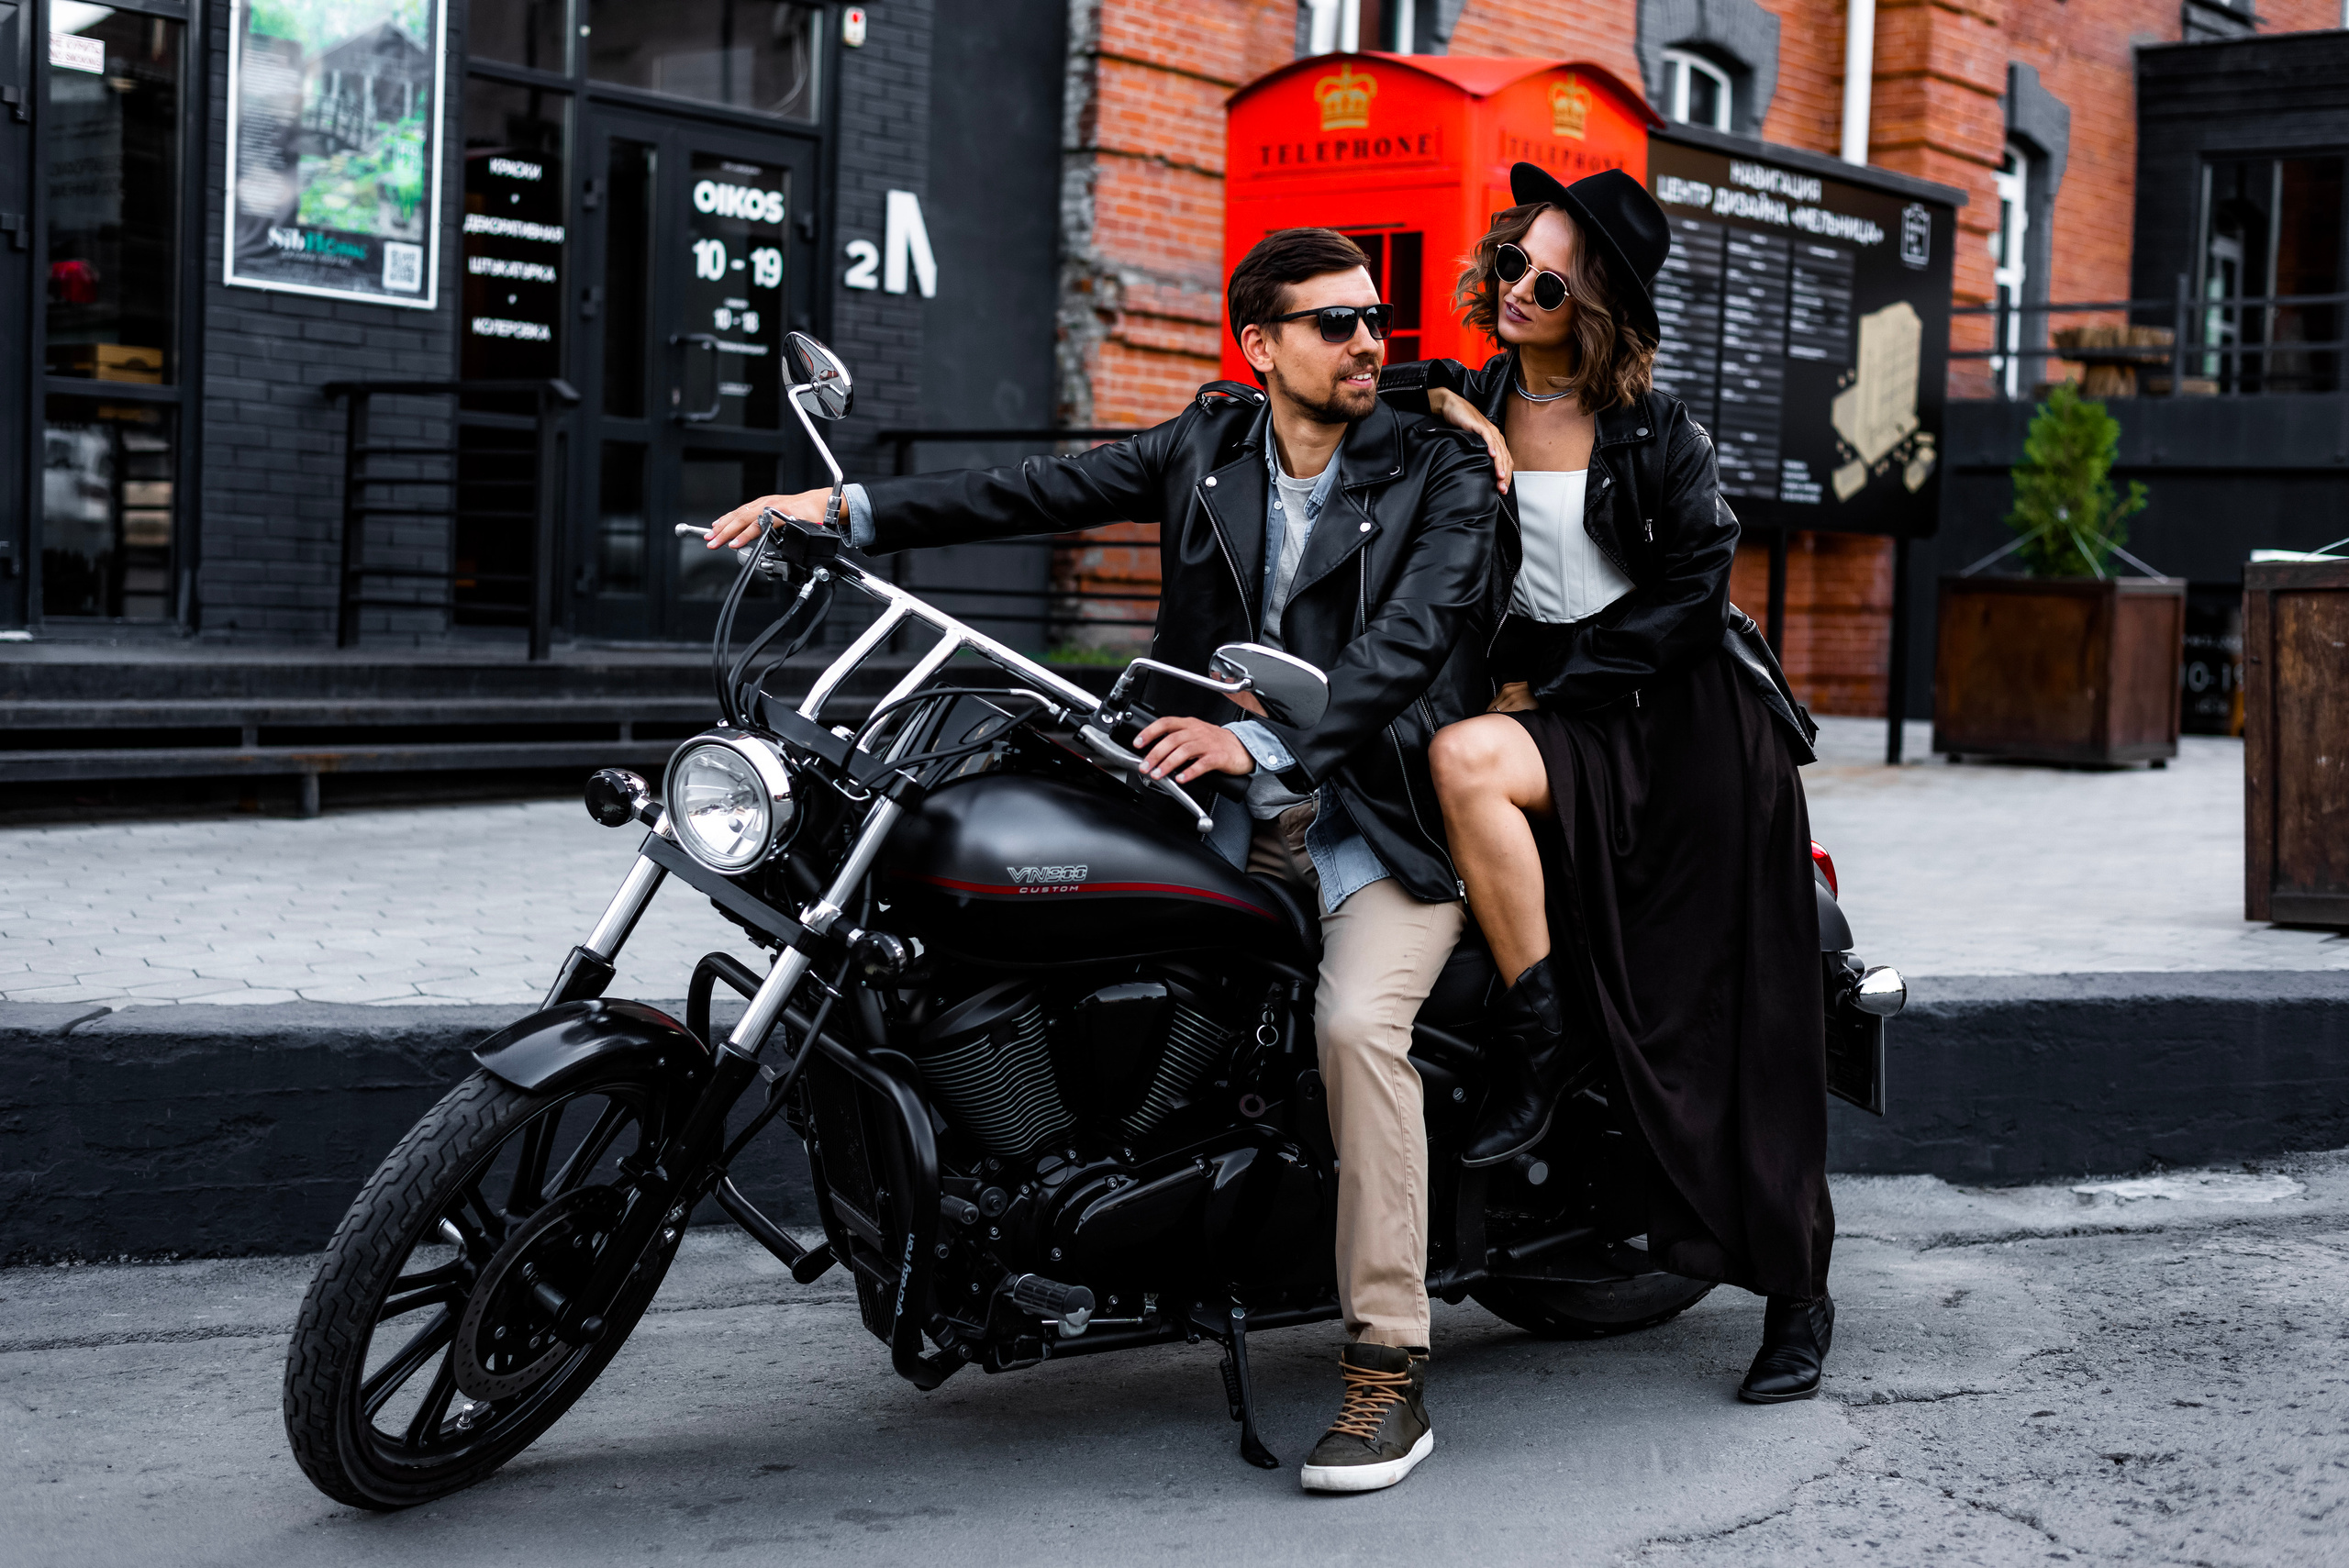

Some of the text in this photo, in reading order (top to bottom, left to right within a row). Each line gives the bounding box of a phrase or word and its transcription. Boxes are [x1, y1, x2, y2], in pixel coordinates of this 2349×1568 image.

[1261, 133, 1431, 166] TELEPHONE
[489, 157, 543, 182] КРАСКИ
[1730, 159, 1823, 204] НАВИГАЦИЯ
[693, 179, 785, 225] OIKOS
[1655, 173, 1714, 209] ЦЕНТР
[1711, 186, 1790, 227] ДИЗАЙНА
[462, 213, 566, 245] ДЕКОРАТИВНАЯ
[468, 255, 557, 284] ШТУКАТУРКА
[472, 316, 551, 342] КОЛЕРОВКА
[1007, 864, 1088, 884] VN900
[1019, 885, 1079, 894] CUSTOM
